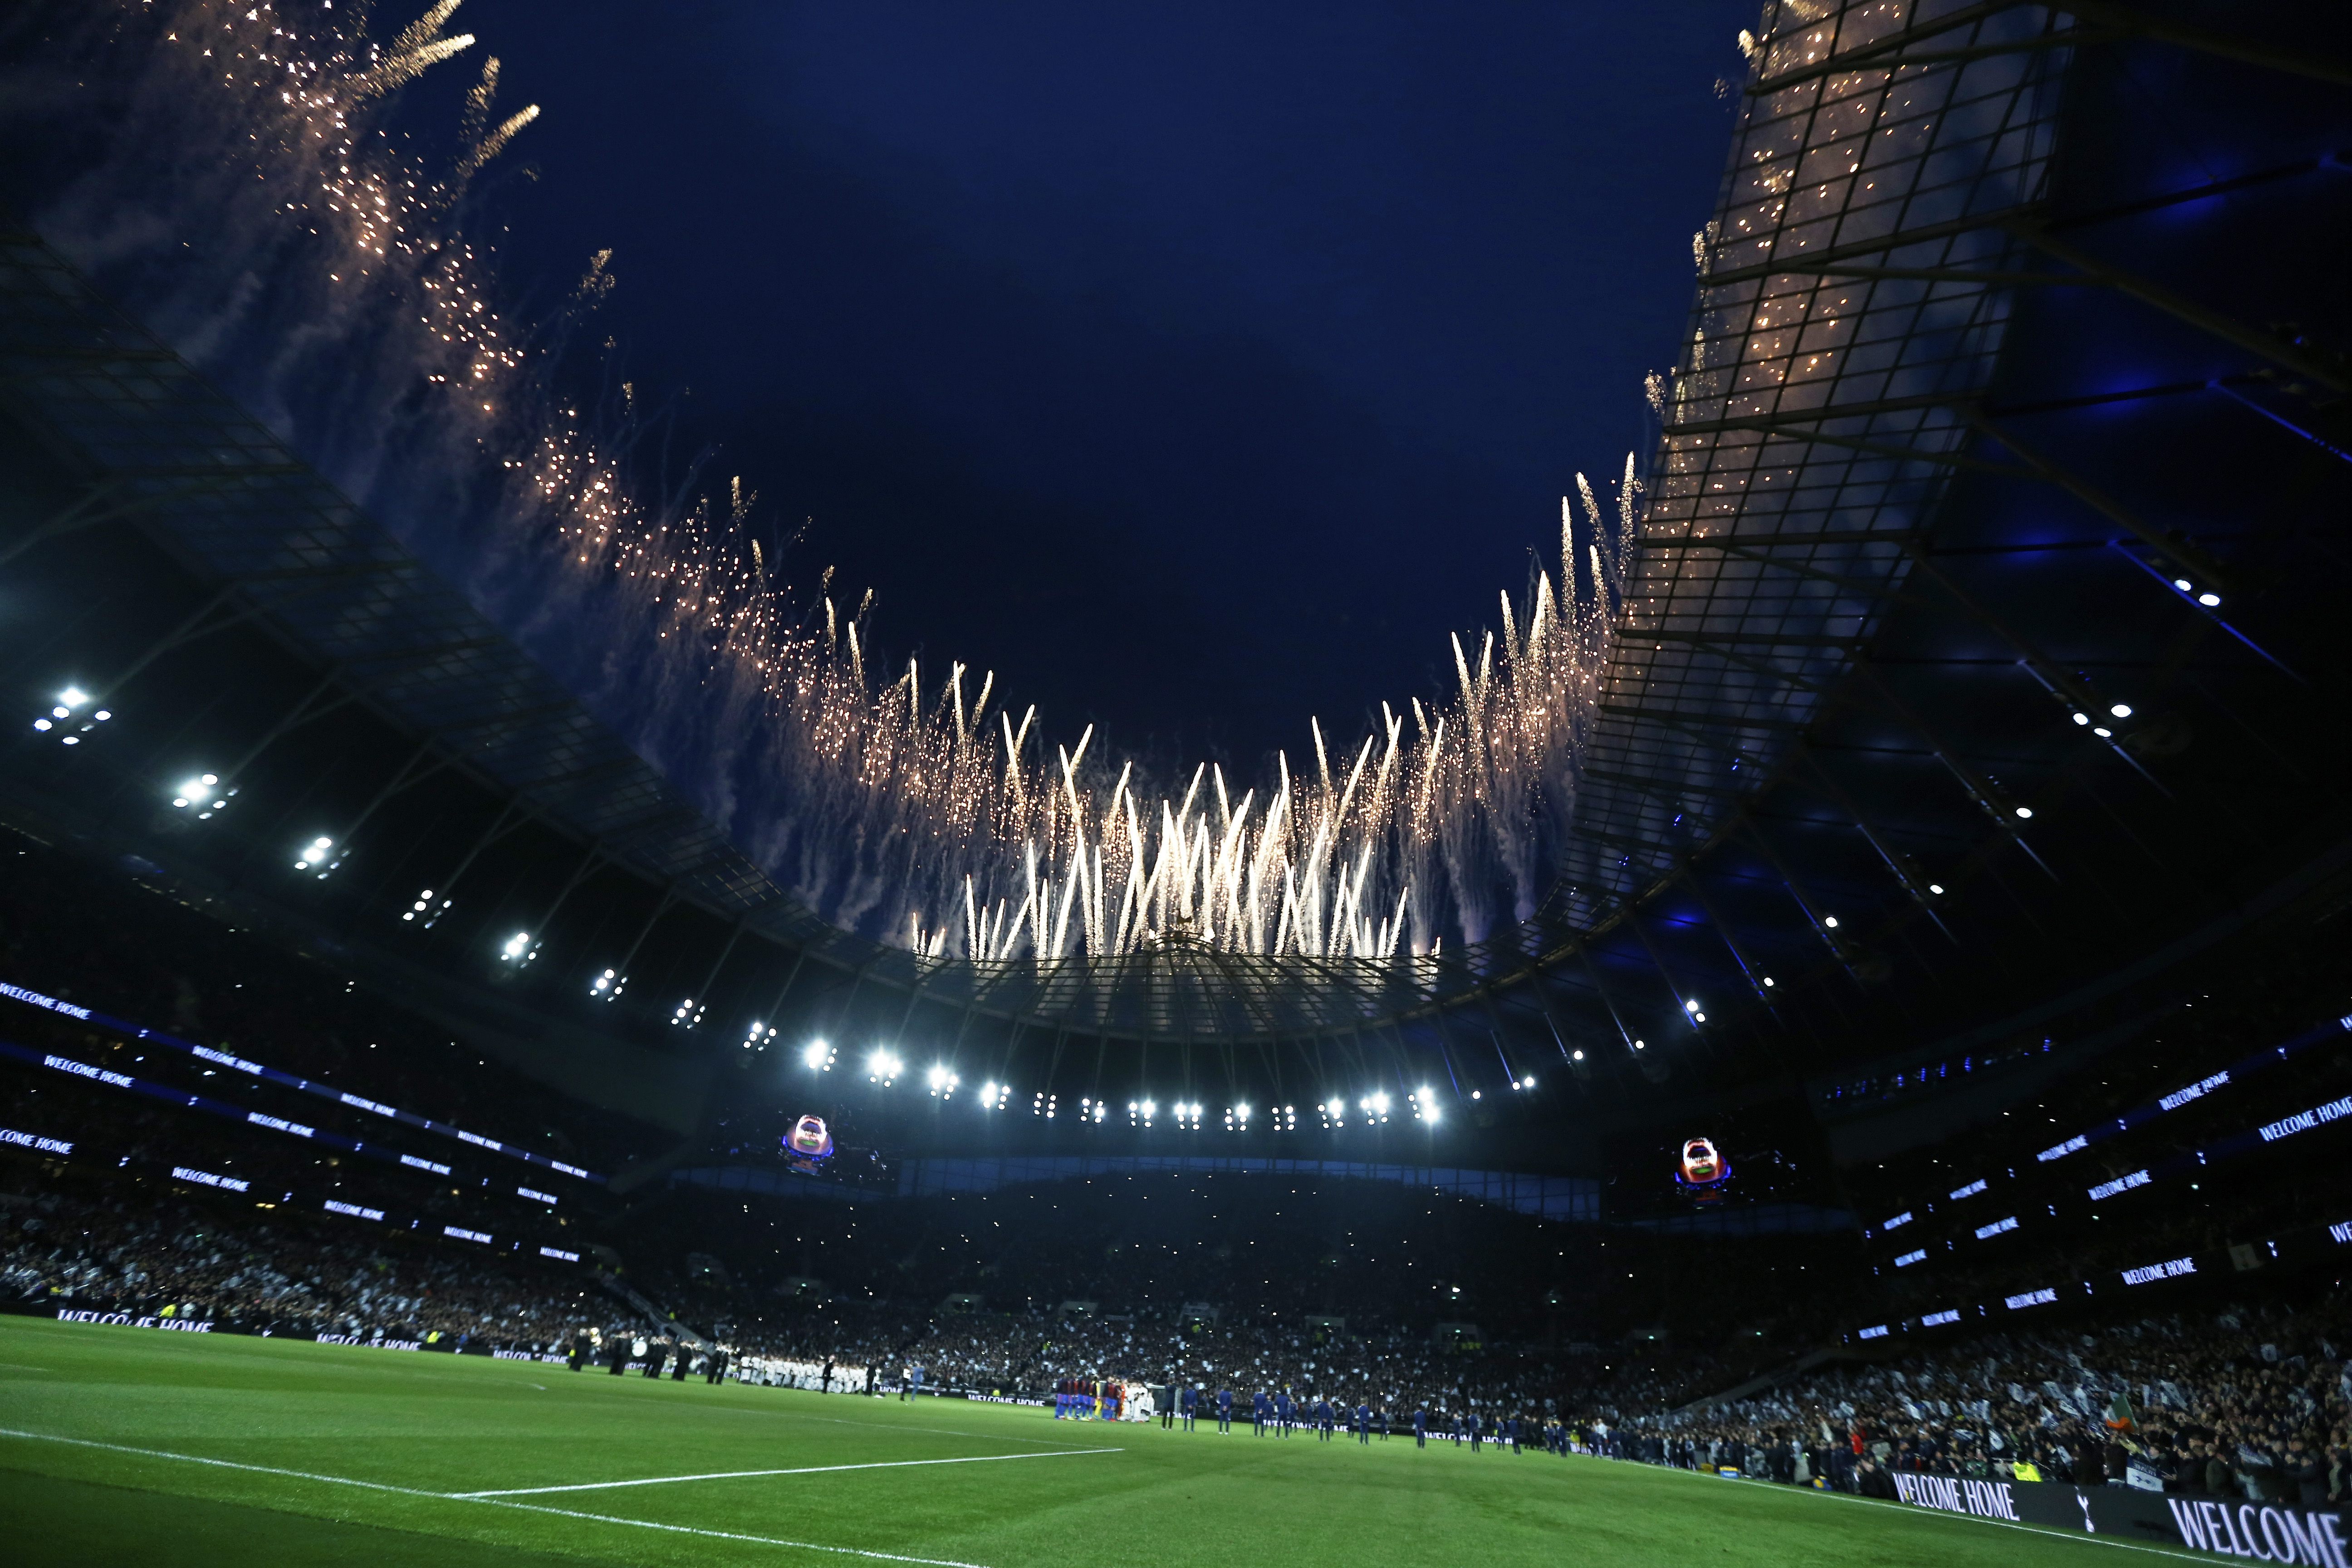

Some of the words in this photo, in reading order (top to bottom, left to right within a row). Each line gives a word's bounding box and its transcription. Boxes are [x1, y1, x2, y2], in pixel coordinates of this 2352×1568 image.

[0, 983, 58, 1009] WELCOME
[55, 1002, 92, 1019] HOME
[44, 1055, 102, 1078] WELCOME
[99, 1071, 135, 1088] HOME
[2259, 1110, 2318, 1141] WELCOME
[34, 1137, 75, 1154] HOME
[2121, 1264, 2168, 1285] WELCOME
[2164, 1257, 2197, 1276] HOME
[1892, 1472, 1966, 1513] WELCOME
[1961, 1479, 2020, 1521] HOME
[2167, 1498, 2350, 1568] WELCOME
